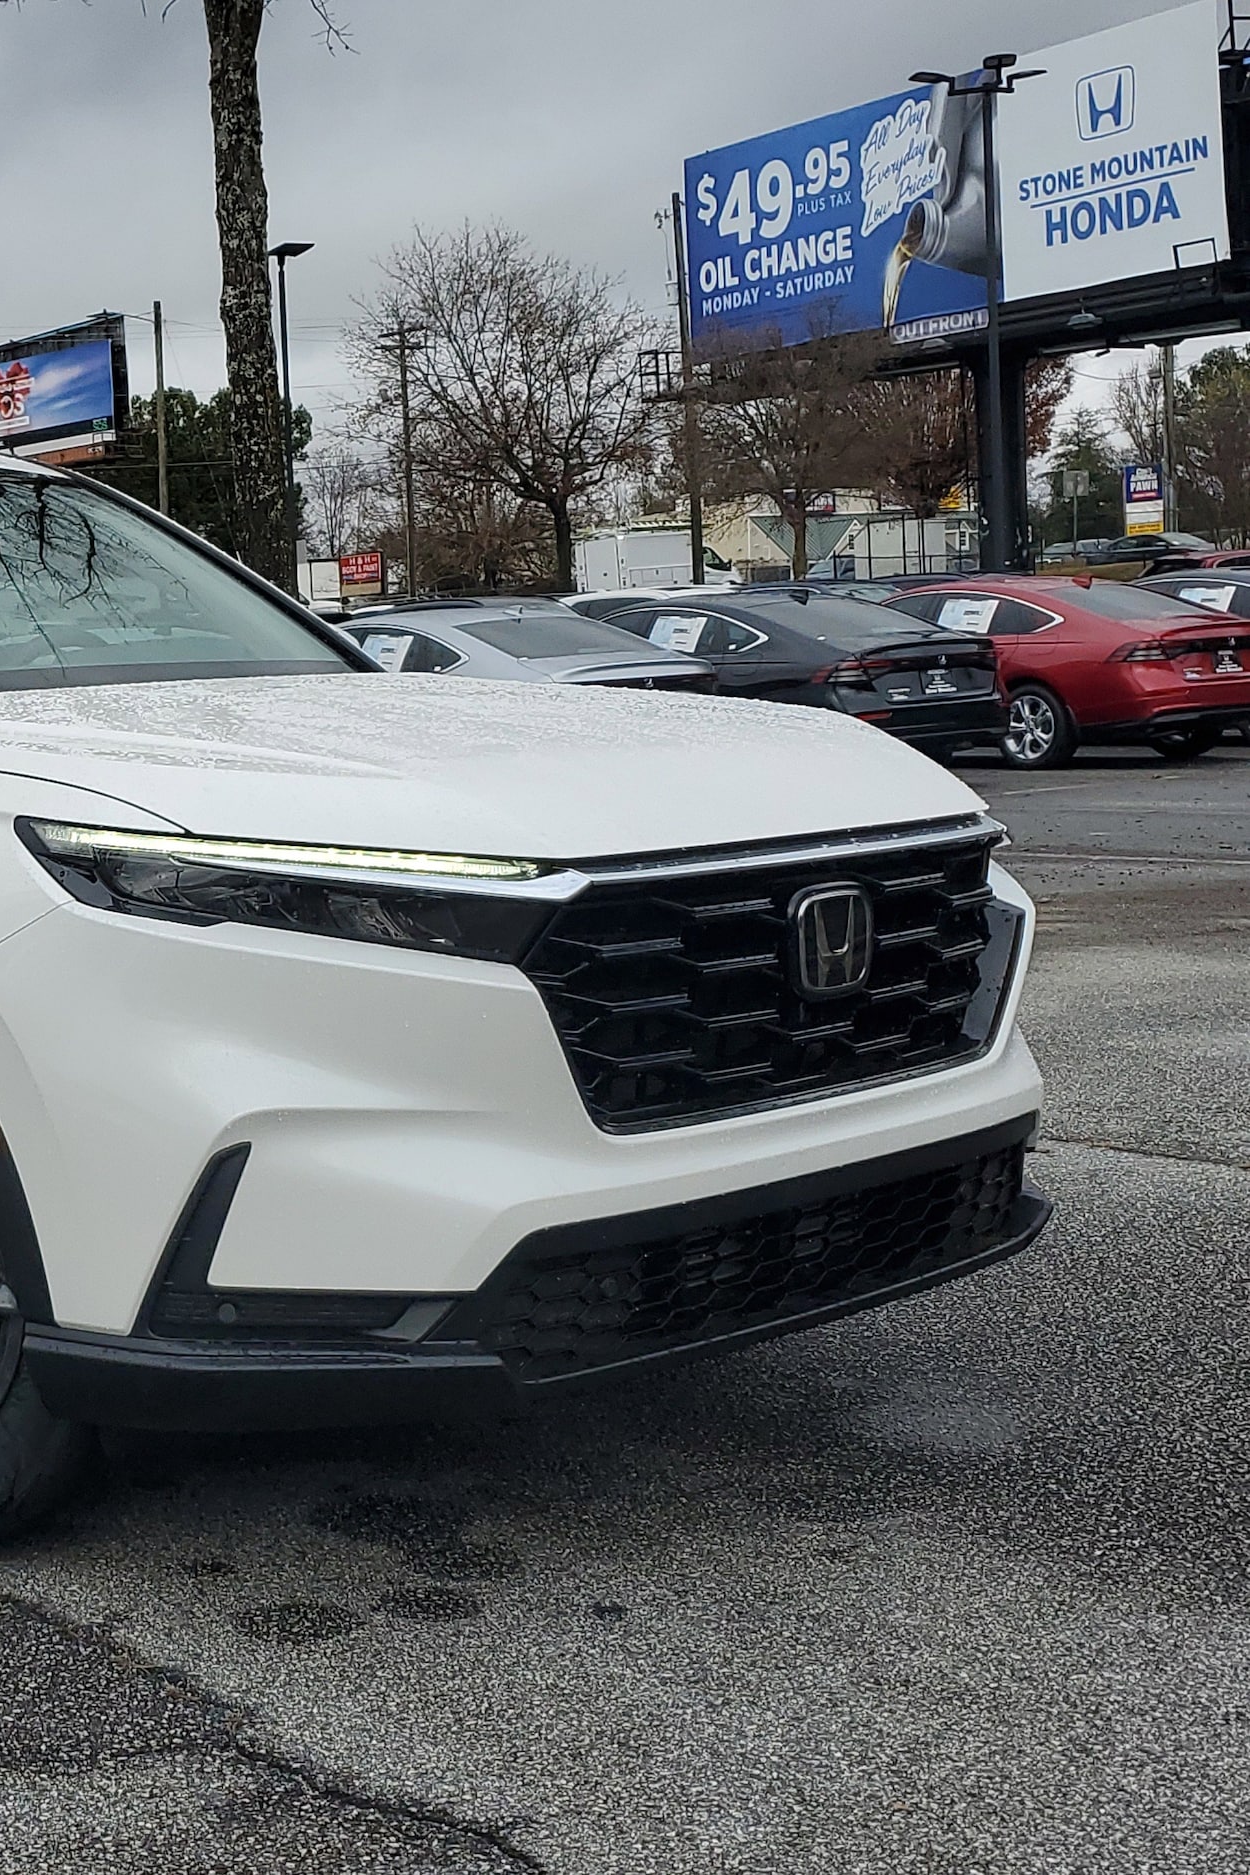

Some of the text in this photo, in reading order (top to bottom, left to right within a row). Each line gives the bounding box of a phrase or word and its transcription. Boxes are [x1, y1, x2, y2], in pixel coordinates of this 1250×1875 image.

[863, 104, 925, 163] All Day
[697, 139, 851, 245] $49.95
[865, 137, 927, 197] Everyday
[1018, 135, 1209, 202] STONE MOUNTAIN
[797, 190, 852, 217] PLUS TAX
[1045, 181, 1182, 247] HONDA
[699, 225, 853, 294] OIL CHANGE
[702, 287, 760, 318] MONDAY
[775, 265, 855, 299] SATURDAY
[1129, 479, 1159, 493] PAWN
